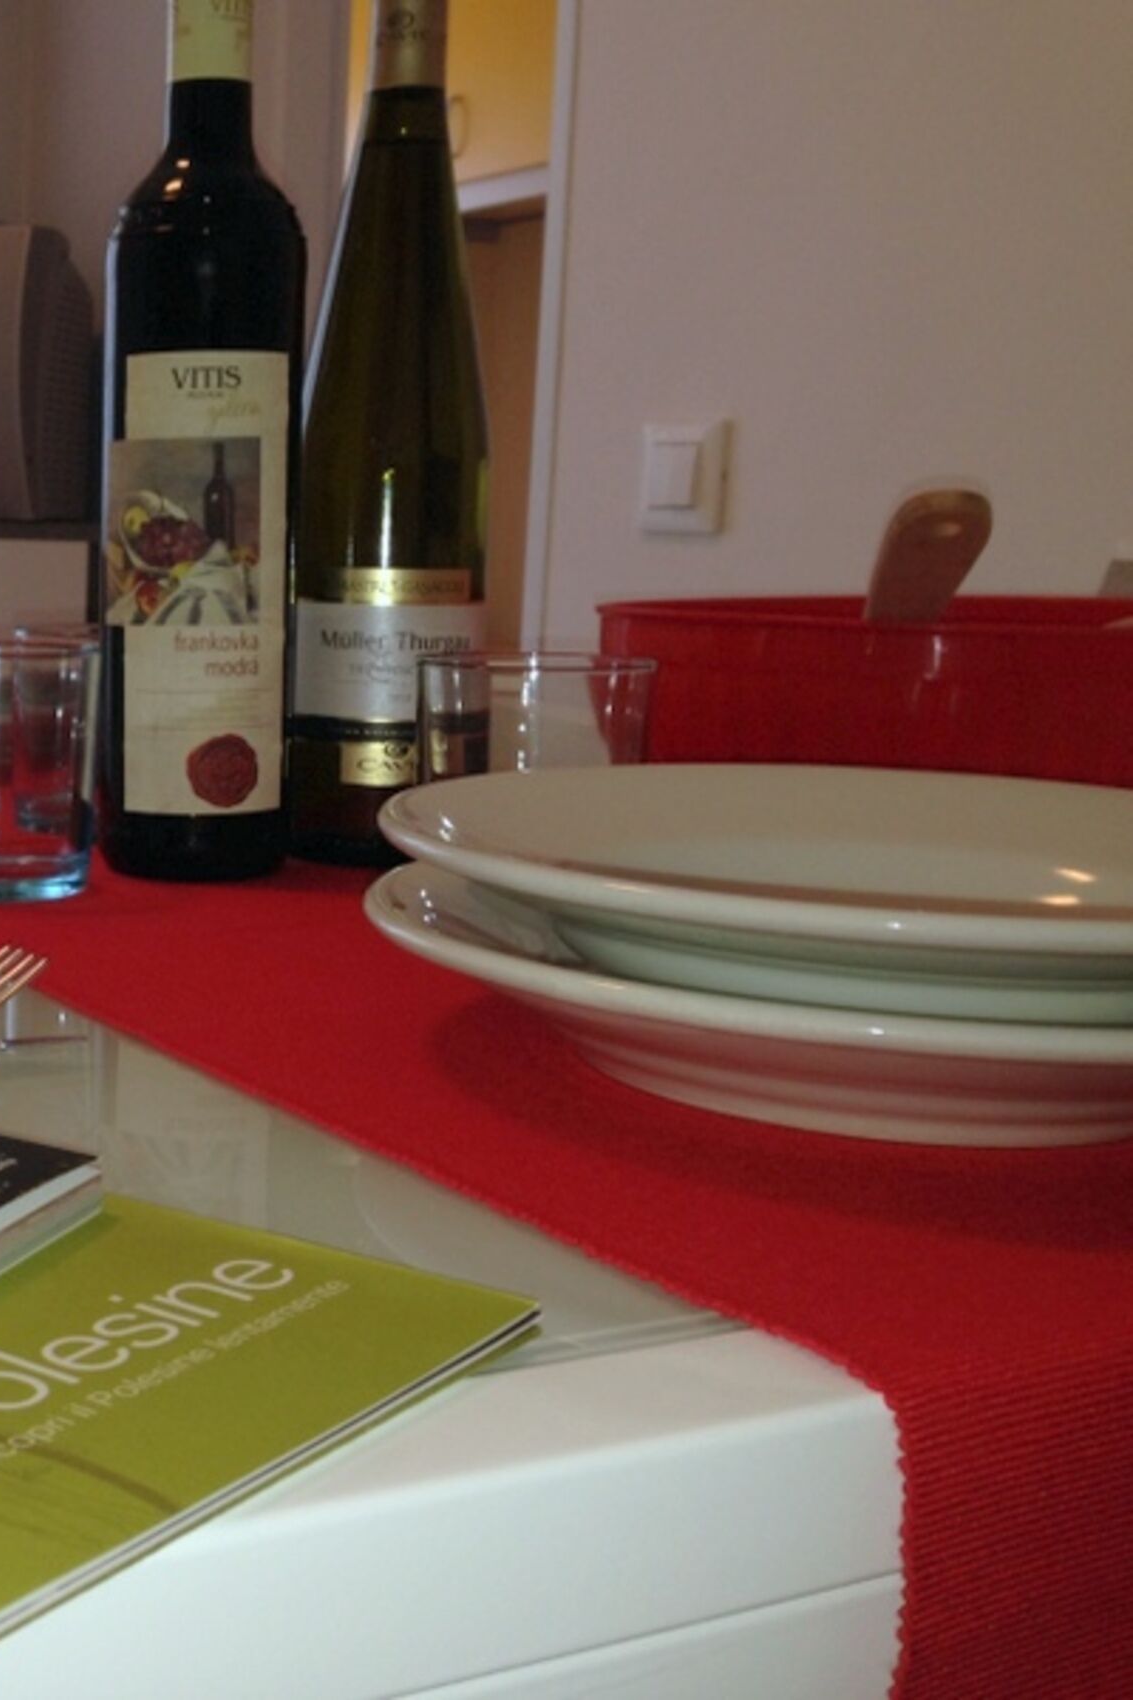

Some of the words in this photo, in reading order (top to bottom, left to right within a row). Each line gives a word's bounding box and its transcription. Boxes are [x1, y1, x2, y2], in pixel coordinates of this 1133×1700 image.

[170, 365, 242, 389] VITIS
[174, 629, 259, 653] frankovka
[86, 1344, 217, 1409] Polesine
[203, 1278, 350, 1351] lentamente
